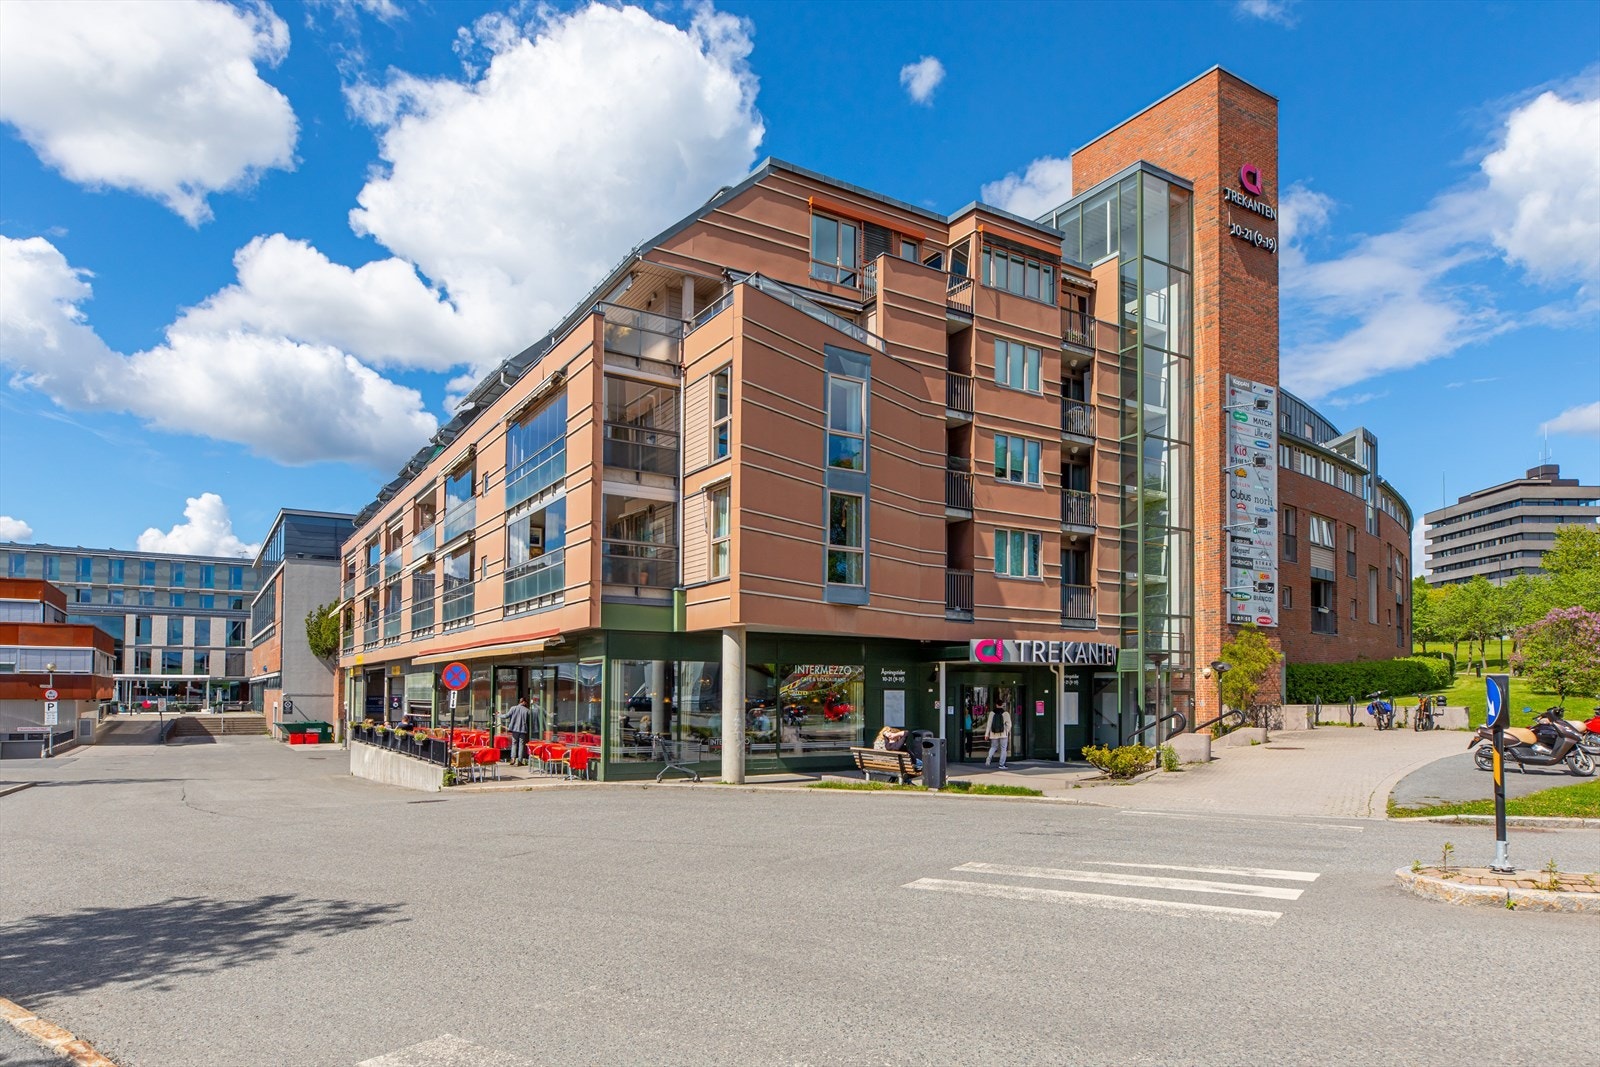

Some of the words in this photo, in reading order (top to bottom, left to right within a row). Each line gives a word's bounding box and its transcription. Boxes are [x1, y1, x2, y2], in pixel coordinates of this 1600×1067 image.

[1224, 187, 1277, 220] TREKANTEN
[1230, 223, 1252, 241] 10-21
[1254, 230, 1277, 254] (9-19)
[1252, 417, 1272, 428] MATCH
[1233, 444, 1248, 457] Kid
[1230, 489, 1252, 502] Cubus
[1254, 496, 1273, 507] norli
[1014, 639, 1117, 666] TREKANTEN
[794, 664, 852, 675] INTERMEZZO
[48, 702, 55, 711] P
